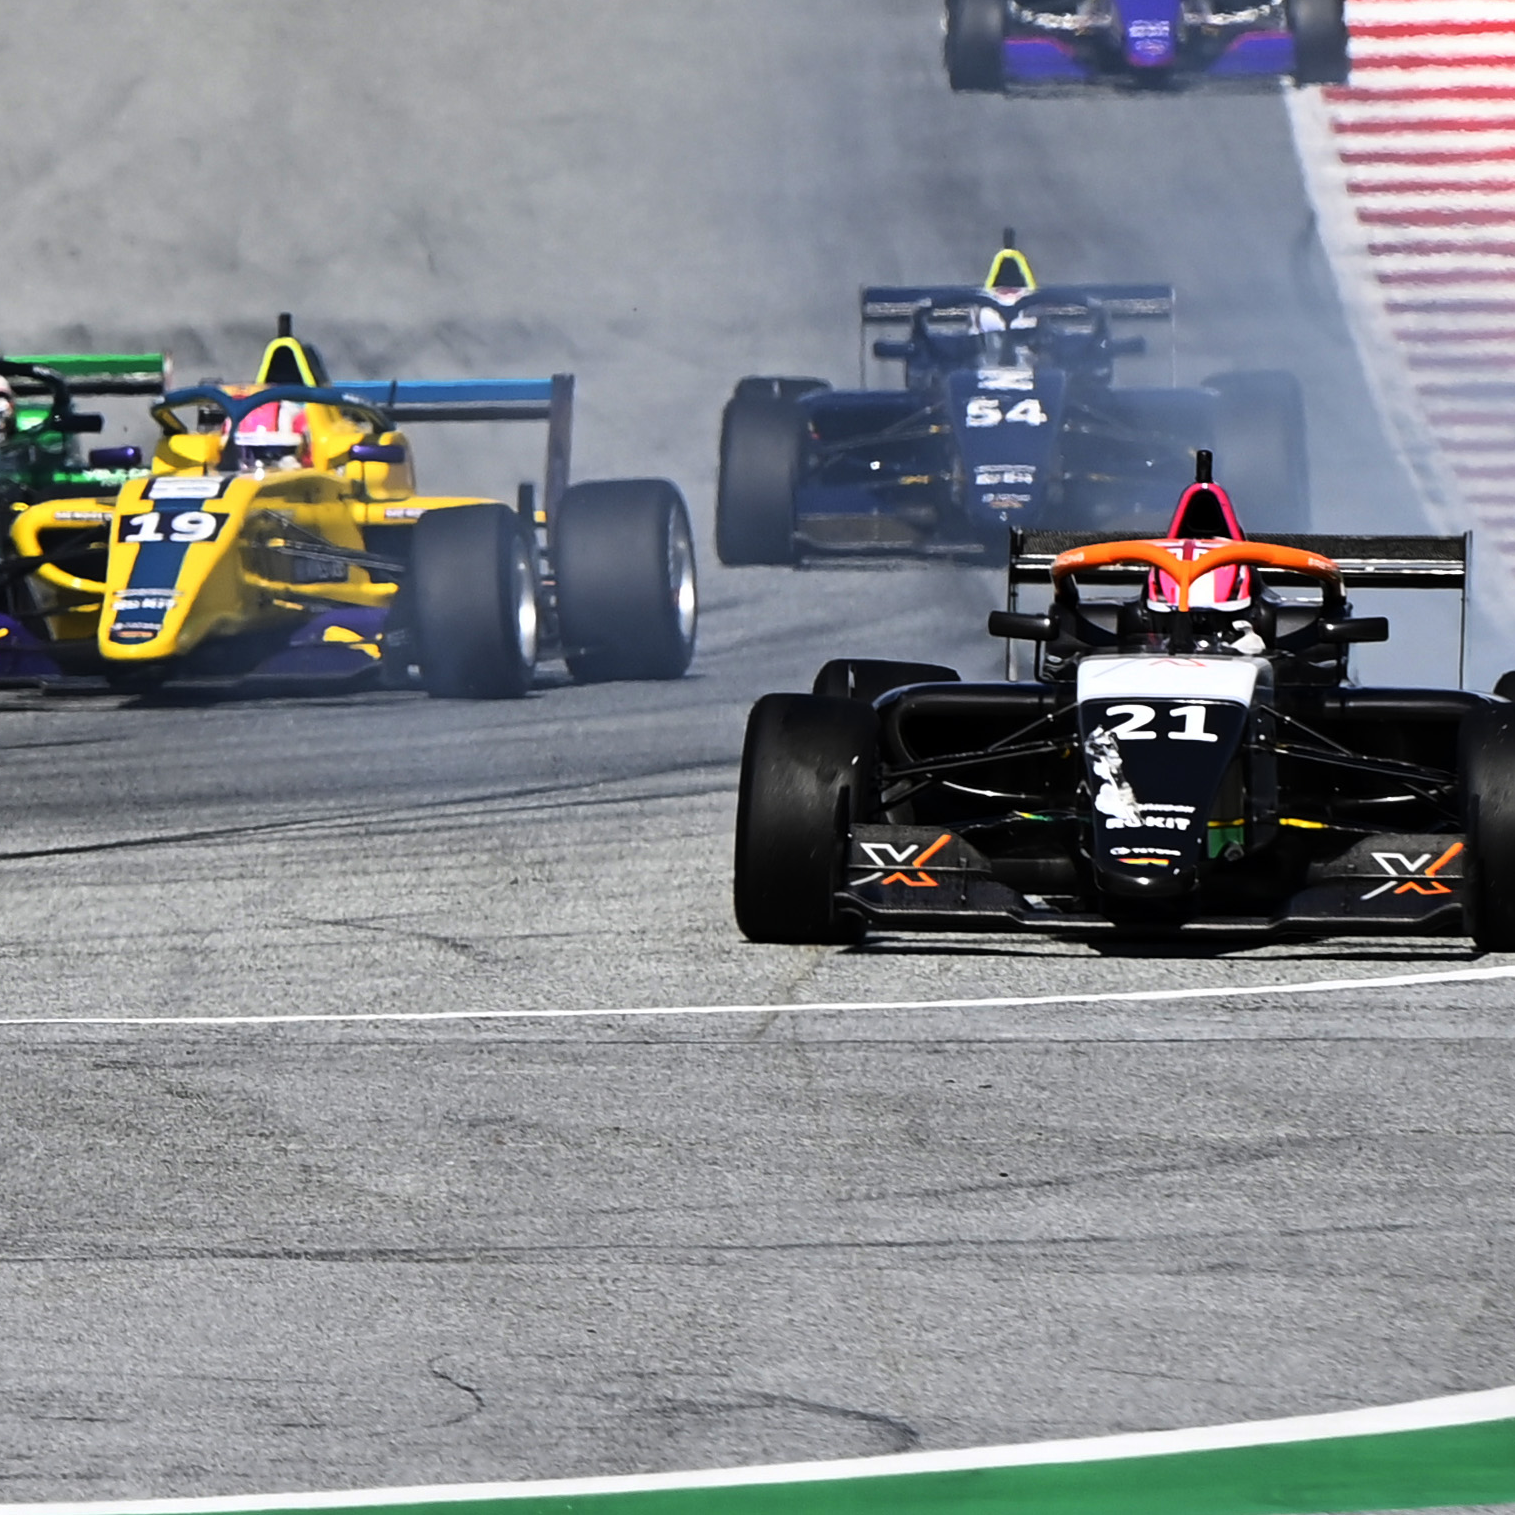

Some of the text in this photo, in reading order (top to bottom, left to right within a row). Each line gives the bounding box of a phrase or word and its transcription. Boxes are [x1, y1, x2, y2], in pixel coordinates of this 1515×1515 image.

[966, 399, 1048, 427] 54
[125, 511, 218, 542] 19
[1106, 704, 1218, 742] 21
